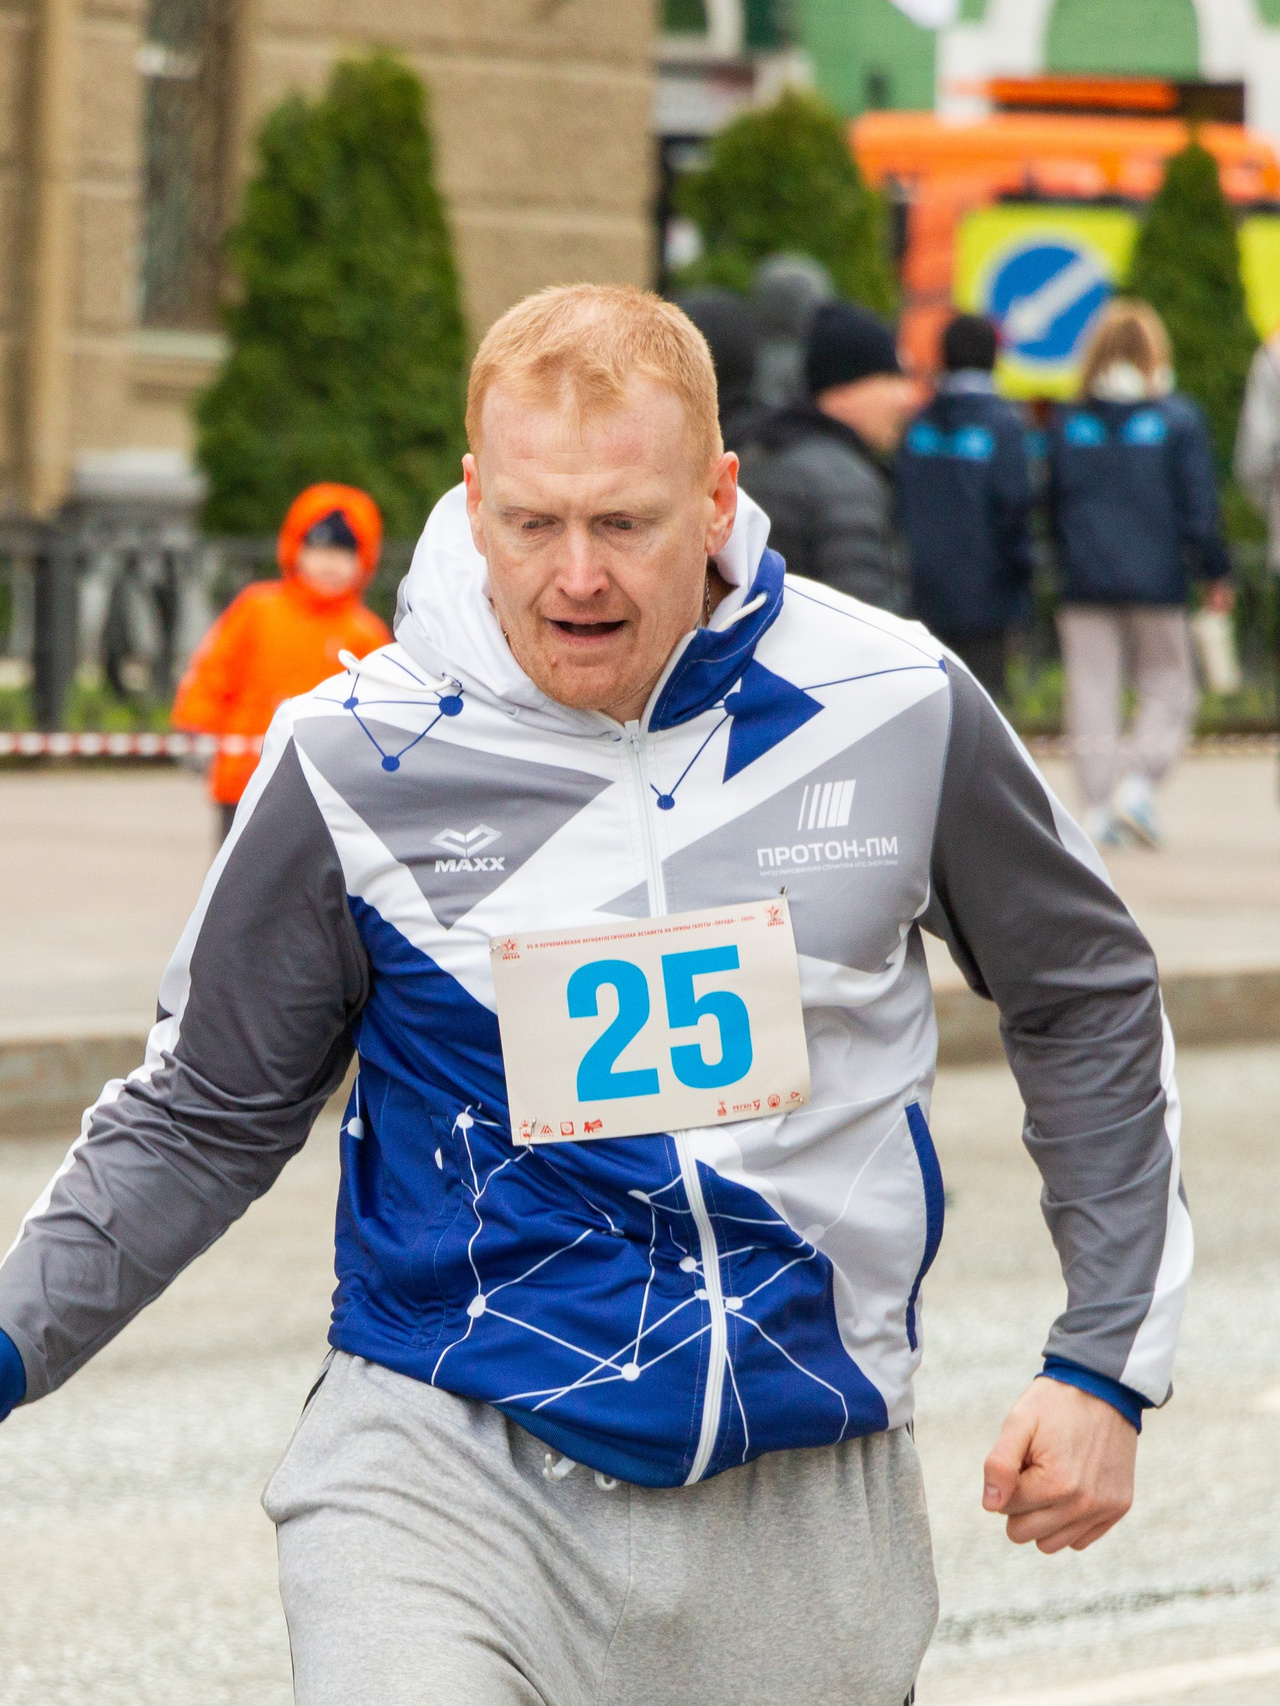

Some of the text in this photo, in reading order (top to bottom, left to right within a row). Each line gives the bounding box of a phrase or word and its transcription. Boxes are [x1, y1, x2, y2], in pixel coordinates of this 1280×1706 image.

[434, 857, 506, 873] MAXX
[757, 836, 899, 867] ПРОТОН-ПМ
[566, 944, 754, 1103] 25
